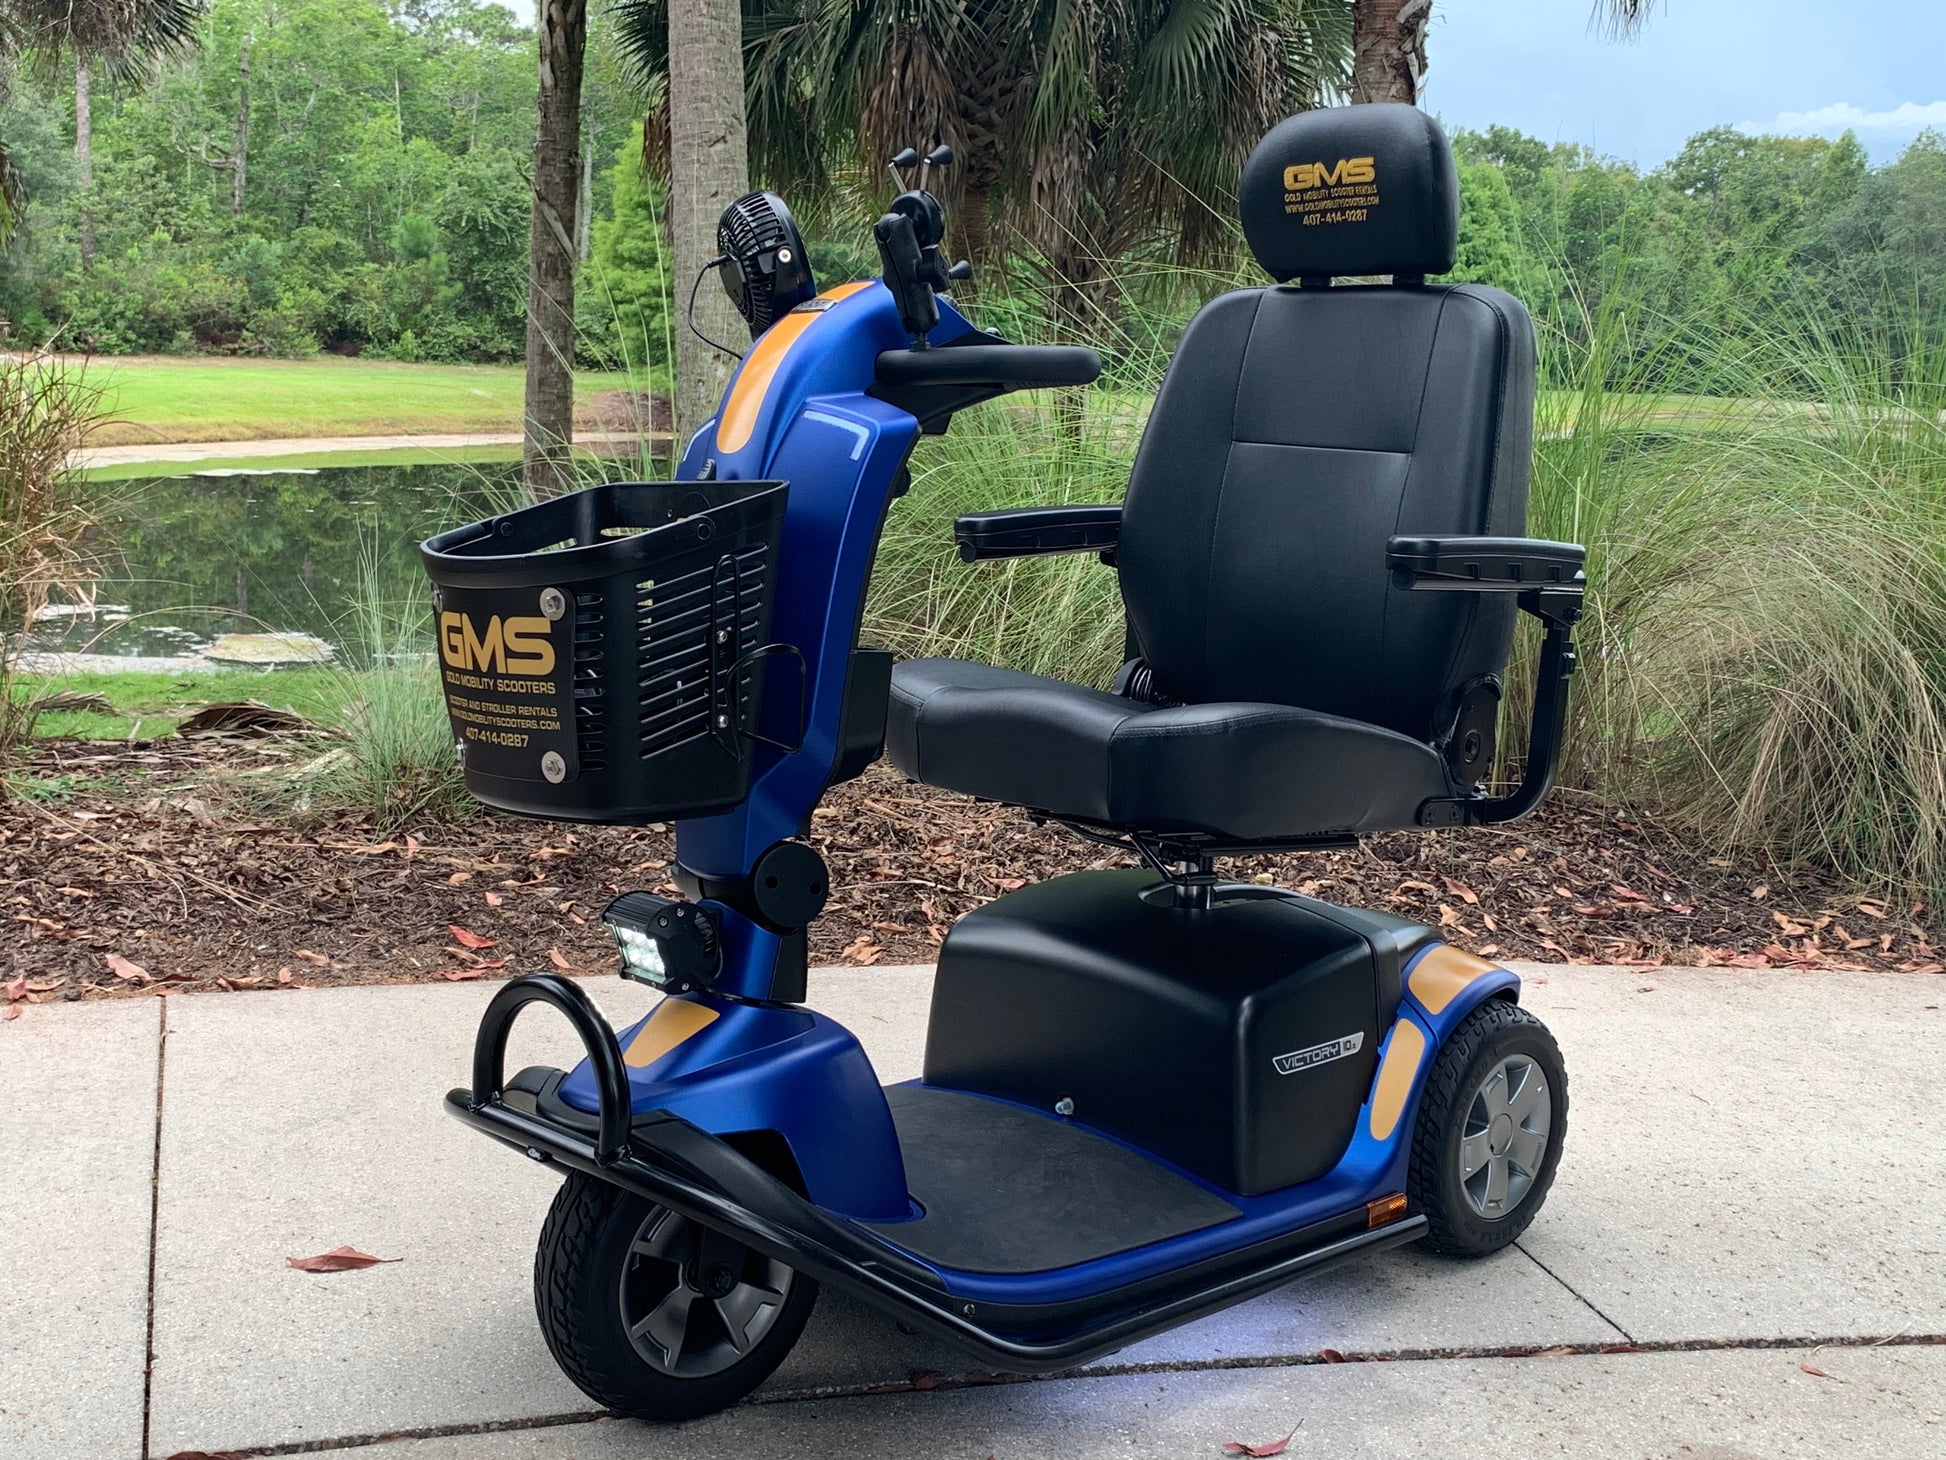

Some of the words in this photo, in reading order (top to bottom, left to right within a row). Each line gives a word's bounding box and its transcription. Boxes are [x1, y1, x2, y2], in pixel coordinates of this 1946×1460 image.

[1284, 157, 1375, 190] GMS
[1285, 192, 1301, 202] GOLD
[1303, 190, 1329, 200] MOBILITY
[1303, 209, 1367, 226] 407-414-0287
[441, 611, 555, 676] GMS
[461, 674, 494, 690] MOBILITY
[497, 680, 555, 694] SCOOTERS
[481, 702, 516, 714] STROLLER
[519, 706, 558, 717] RENTALS
[466, 726, 529, 748] 407-414-0287
[1282, 1043, 1339, 1069] VICTORY
